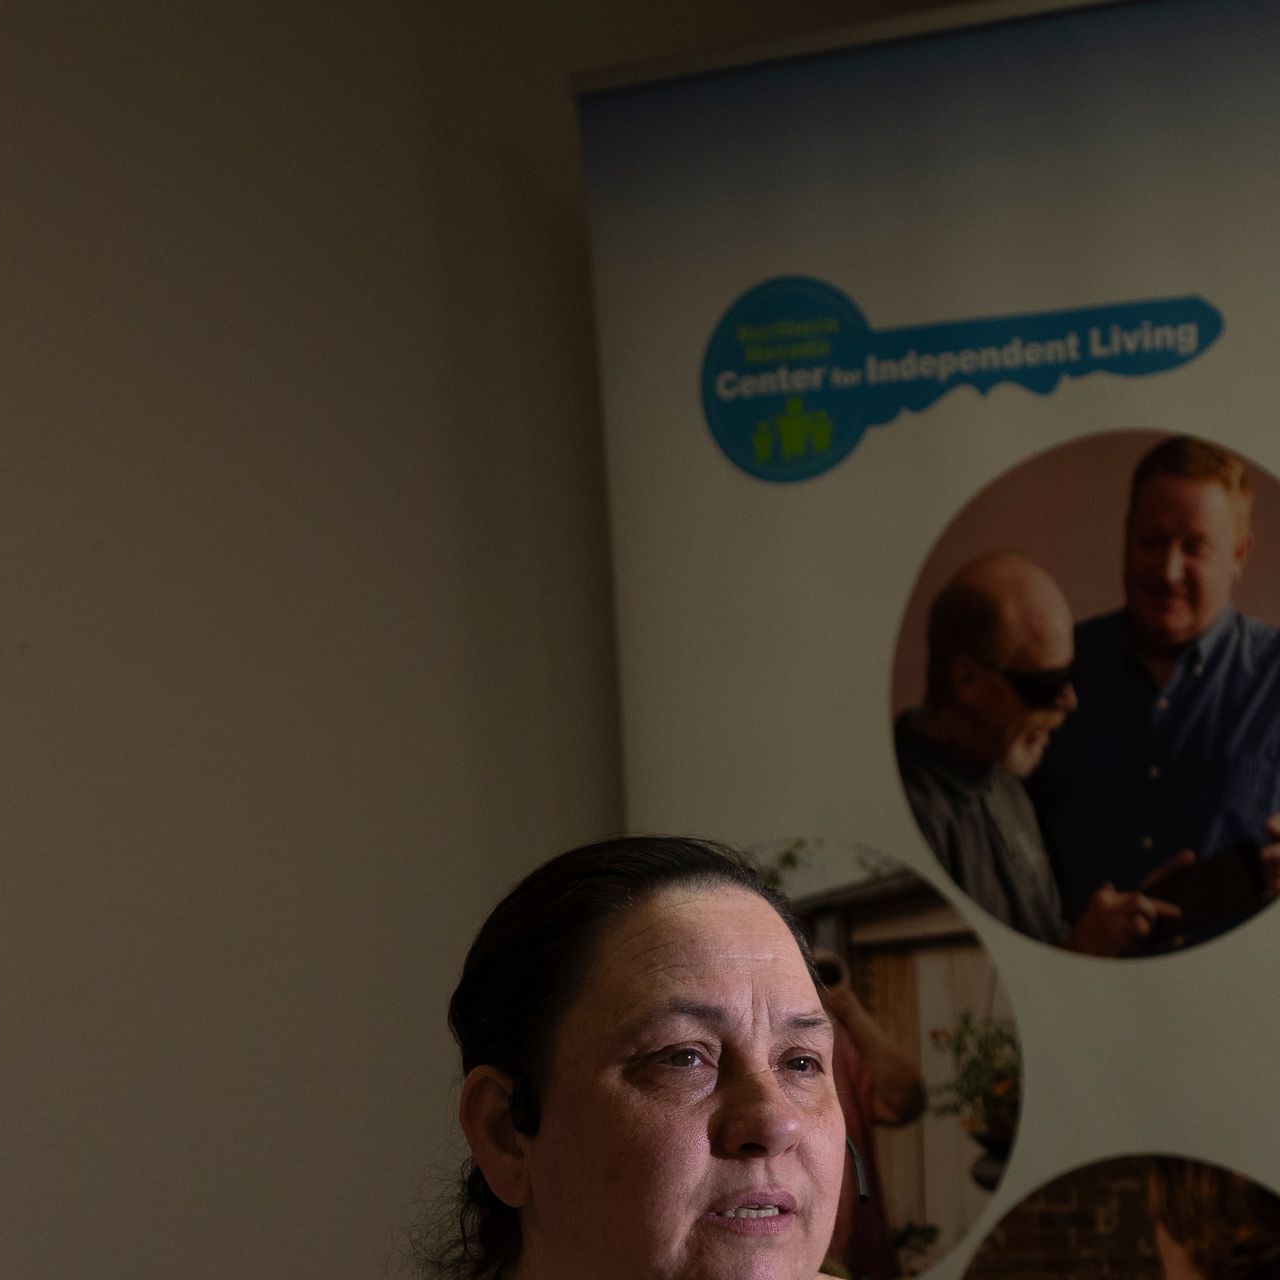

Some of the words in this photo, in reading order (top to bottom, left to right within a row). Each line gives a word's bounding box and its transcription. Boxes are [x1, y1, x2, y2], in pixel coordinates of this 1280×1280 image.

[715, 364, 825, 401] Center
[830, 366, 864, 390] for
[865, 331, 1079, 385] Independent
[1089, 319, 1200, 356] Living
